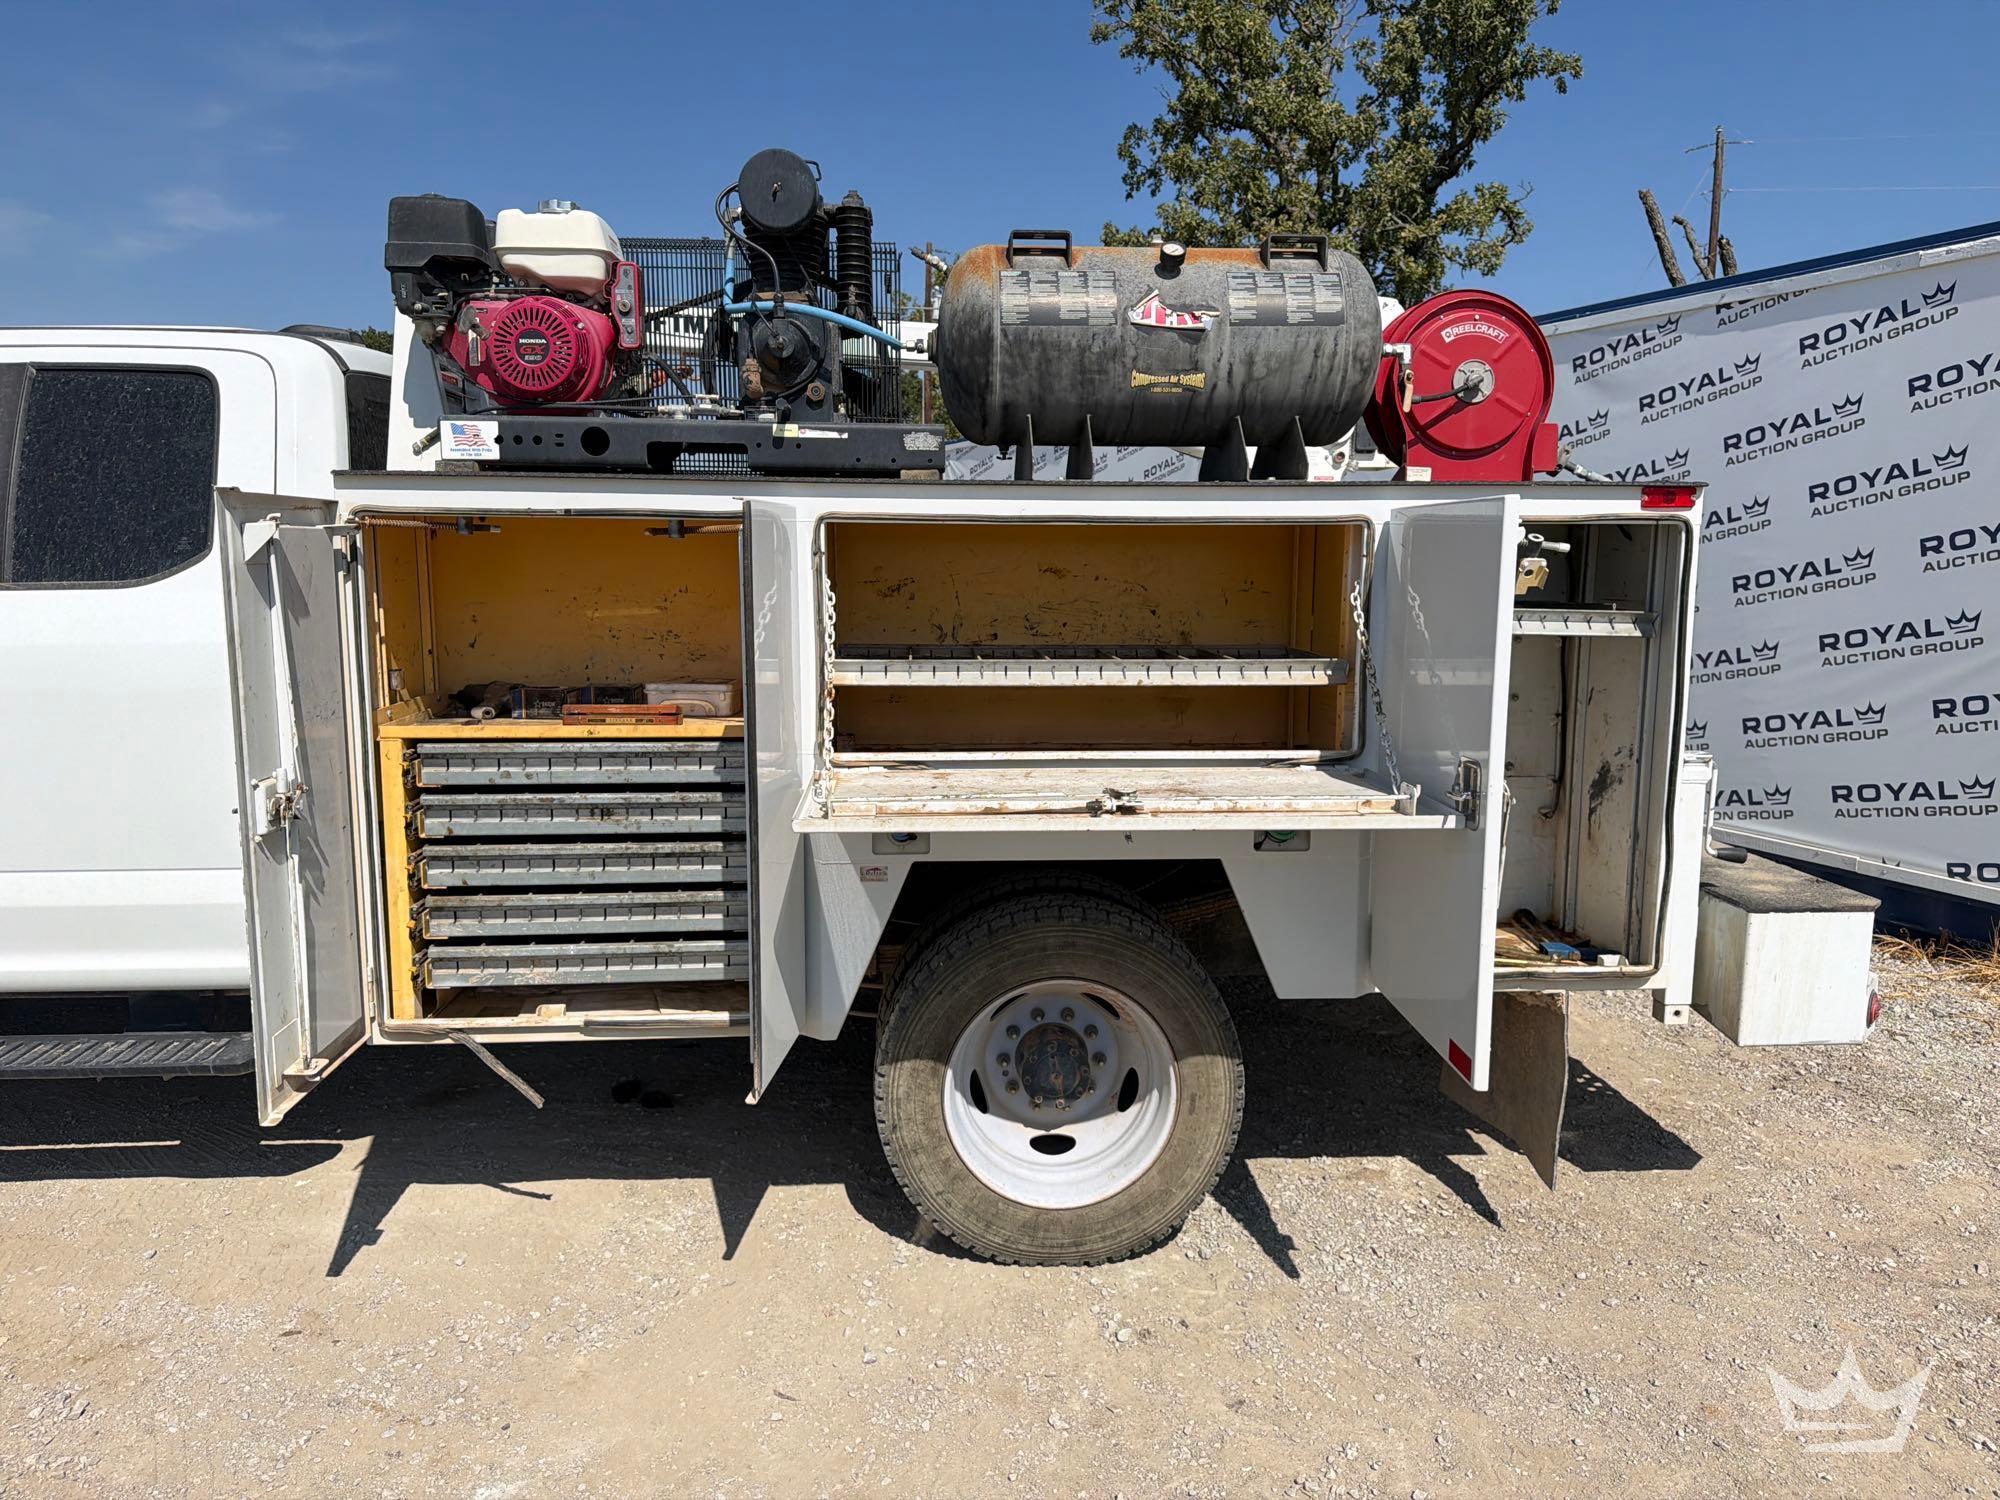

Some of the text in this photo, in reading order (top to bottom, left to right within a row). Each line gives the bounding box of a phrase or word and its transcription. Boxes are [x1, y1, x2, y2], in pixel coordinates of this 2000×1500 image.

[1717, 290, 1789, 329] AUCTION
[1452, 324, 1504, 340] REELCRAFT
[1799, 299, 1921, 355] ROYAL
[1801, 306, 1959, 370] AUCTION GROUP
[519, 345, 545, 354] GX
[1572, 328, 1656, 373] ROYAL
[1574, 335, 1682, 385] AUCTION GROUP
[1131, 369, 1205, 389] Compressed Air Systems
[1639, 367, 1734, 413] ROYAL
[1908, 353, 2000, 397] ROY
[1641, 375, 1762, 425] AUCTION GROUP
[1723, 408, 1832, 453] ROYAL
[1725, 418, 1866, 467] AUCTION GROUP
[1143, 455, 1177, 480] ROYAL
[1808, 458, 1932, 503] ROYAL
[1810, 470, 1971, 518] AUCTION GROUP
[1716, 519, 1771, 541] GROUP
[1732, 558, 1842, 593] ROYAL
[1734, 572, 1877, 607] AUCTION GROUP
[1819, 619, 1944, 652] ROYAL
[1821, 636, 1984, 667] AUCTION GROUP
[1690, 647, 1751, 671] YAL
[1725, 663, 1781, 681] GROUP
[1742, 709, 1853, 735] ROYAL
[1744, 728, 1888, 749] AUCTION GROUP
[1831, 781, 1959, 803] ROYAL
[1737, 809, 1794, 820] GROUP
[1834, 804, 1998, 818] AUCTION GROUP
